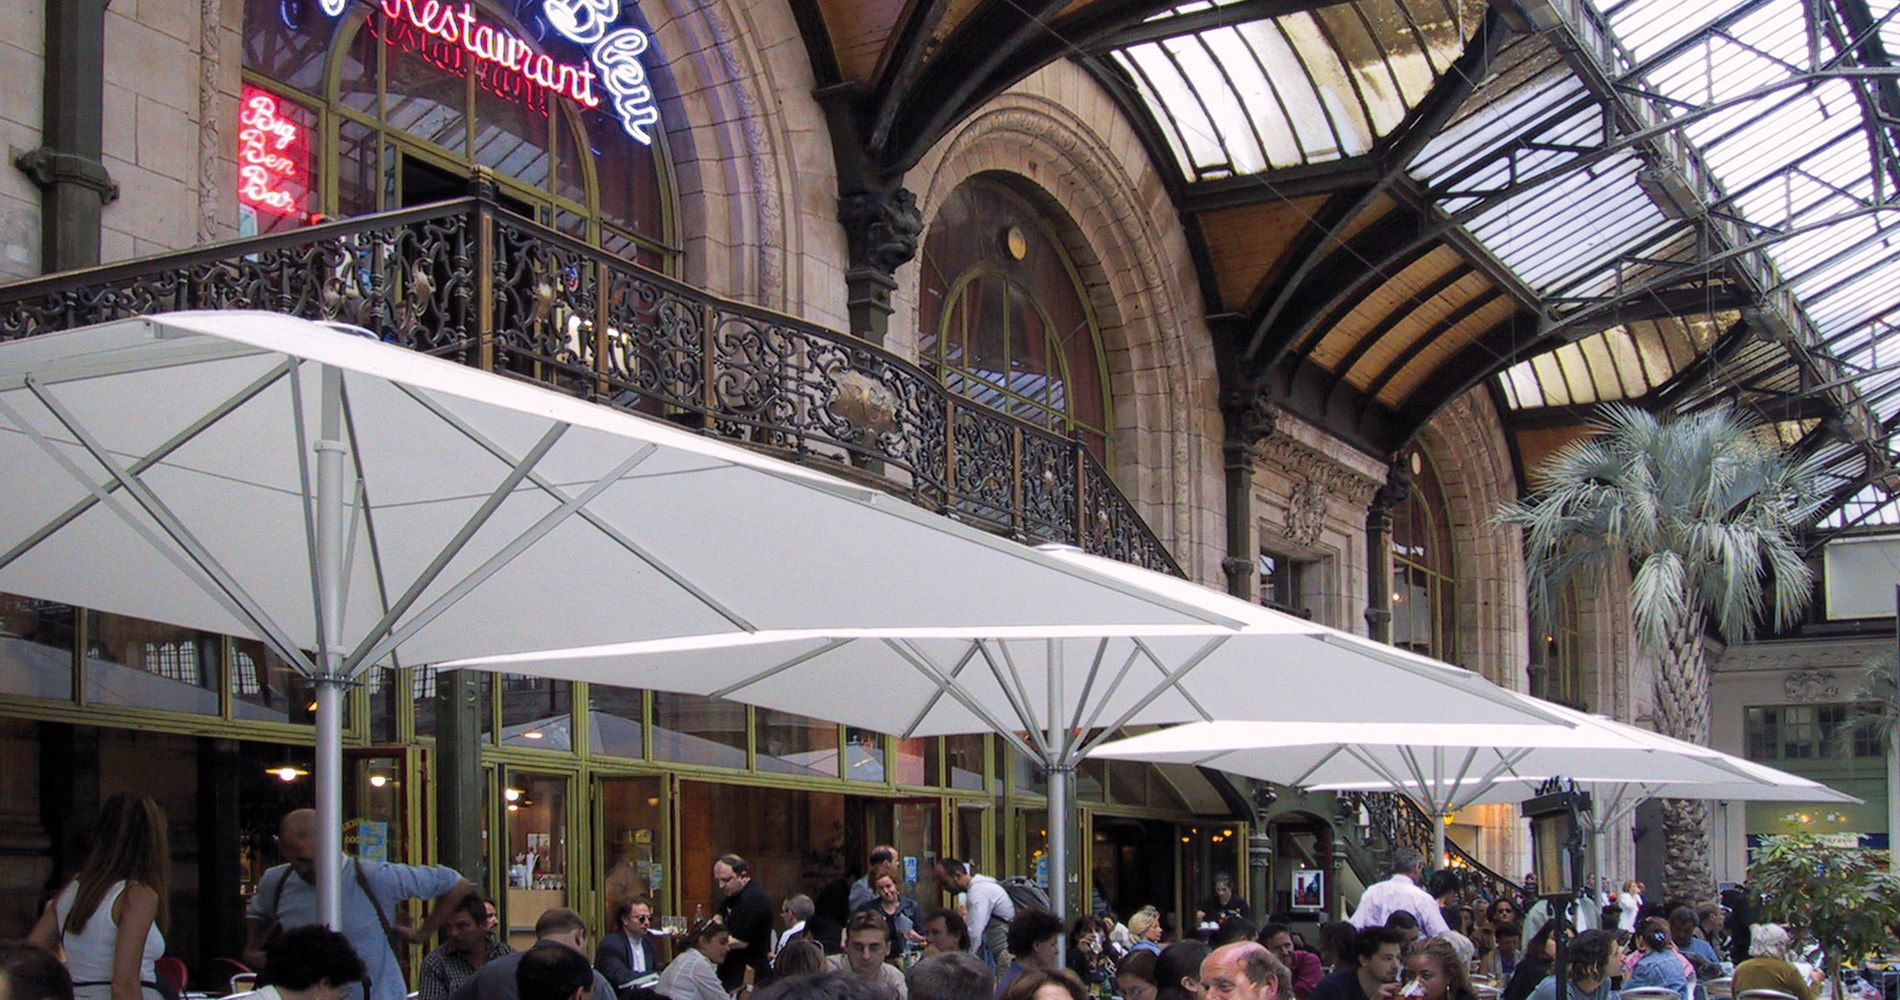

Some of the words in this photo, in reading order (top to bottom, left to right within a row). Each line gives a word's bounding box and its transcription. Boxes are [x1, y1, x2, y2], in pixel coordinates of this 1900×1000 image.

[240, 95, 297, 150] Big
[239, 128, 296, 176] Ben
[239, 165, 296, 213] Bar
